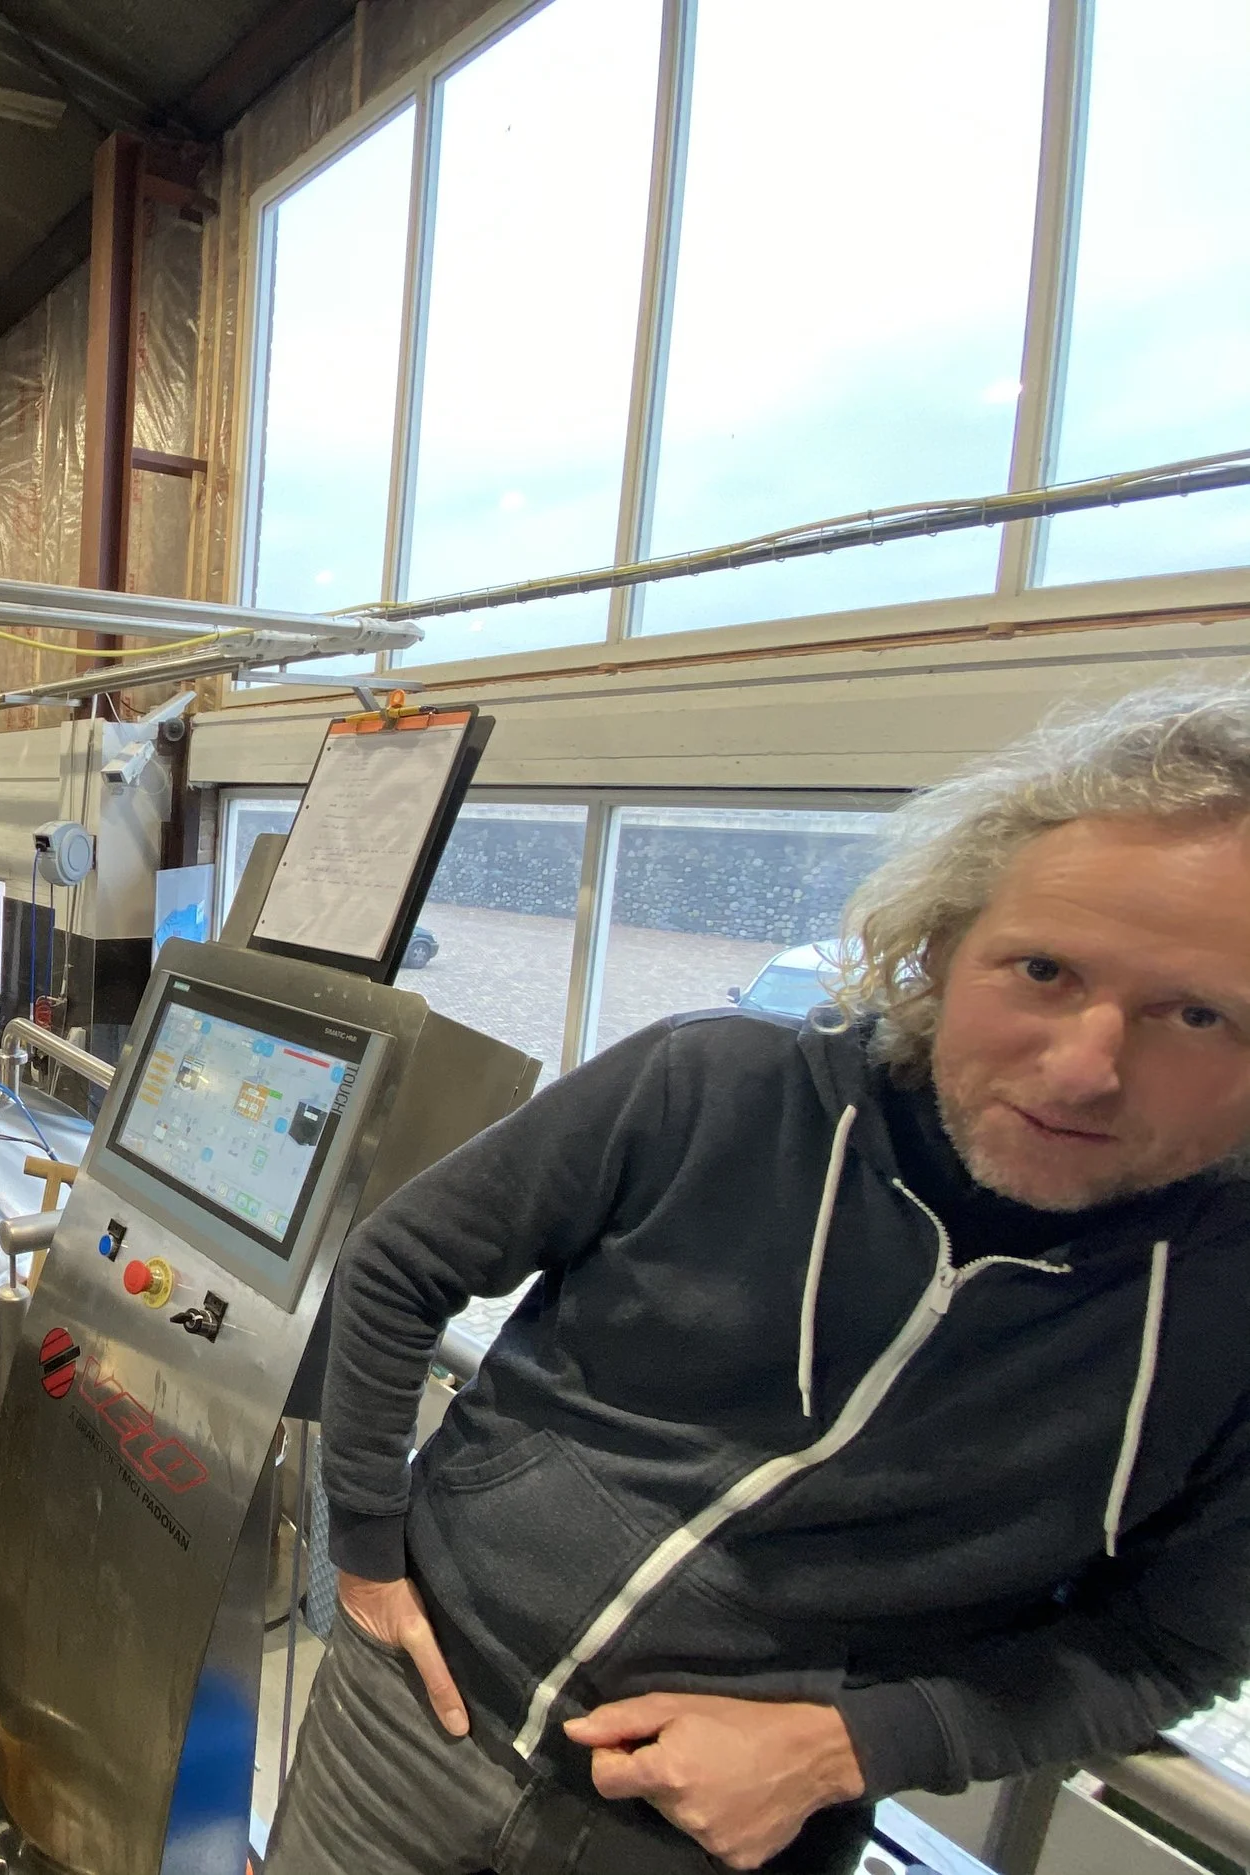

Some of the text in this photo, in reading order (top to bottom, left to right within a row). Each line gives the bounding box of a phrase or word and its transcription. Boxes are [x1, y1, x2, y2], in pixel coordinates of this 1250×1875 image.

[324, 1027, 347, 1041] SIMATIC
[331, 1065, 360, 1115] TOUCH
[75, 1418, 104, 1453] BRAND
[141, 1492, 190, 1553] PADOVAN
